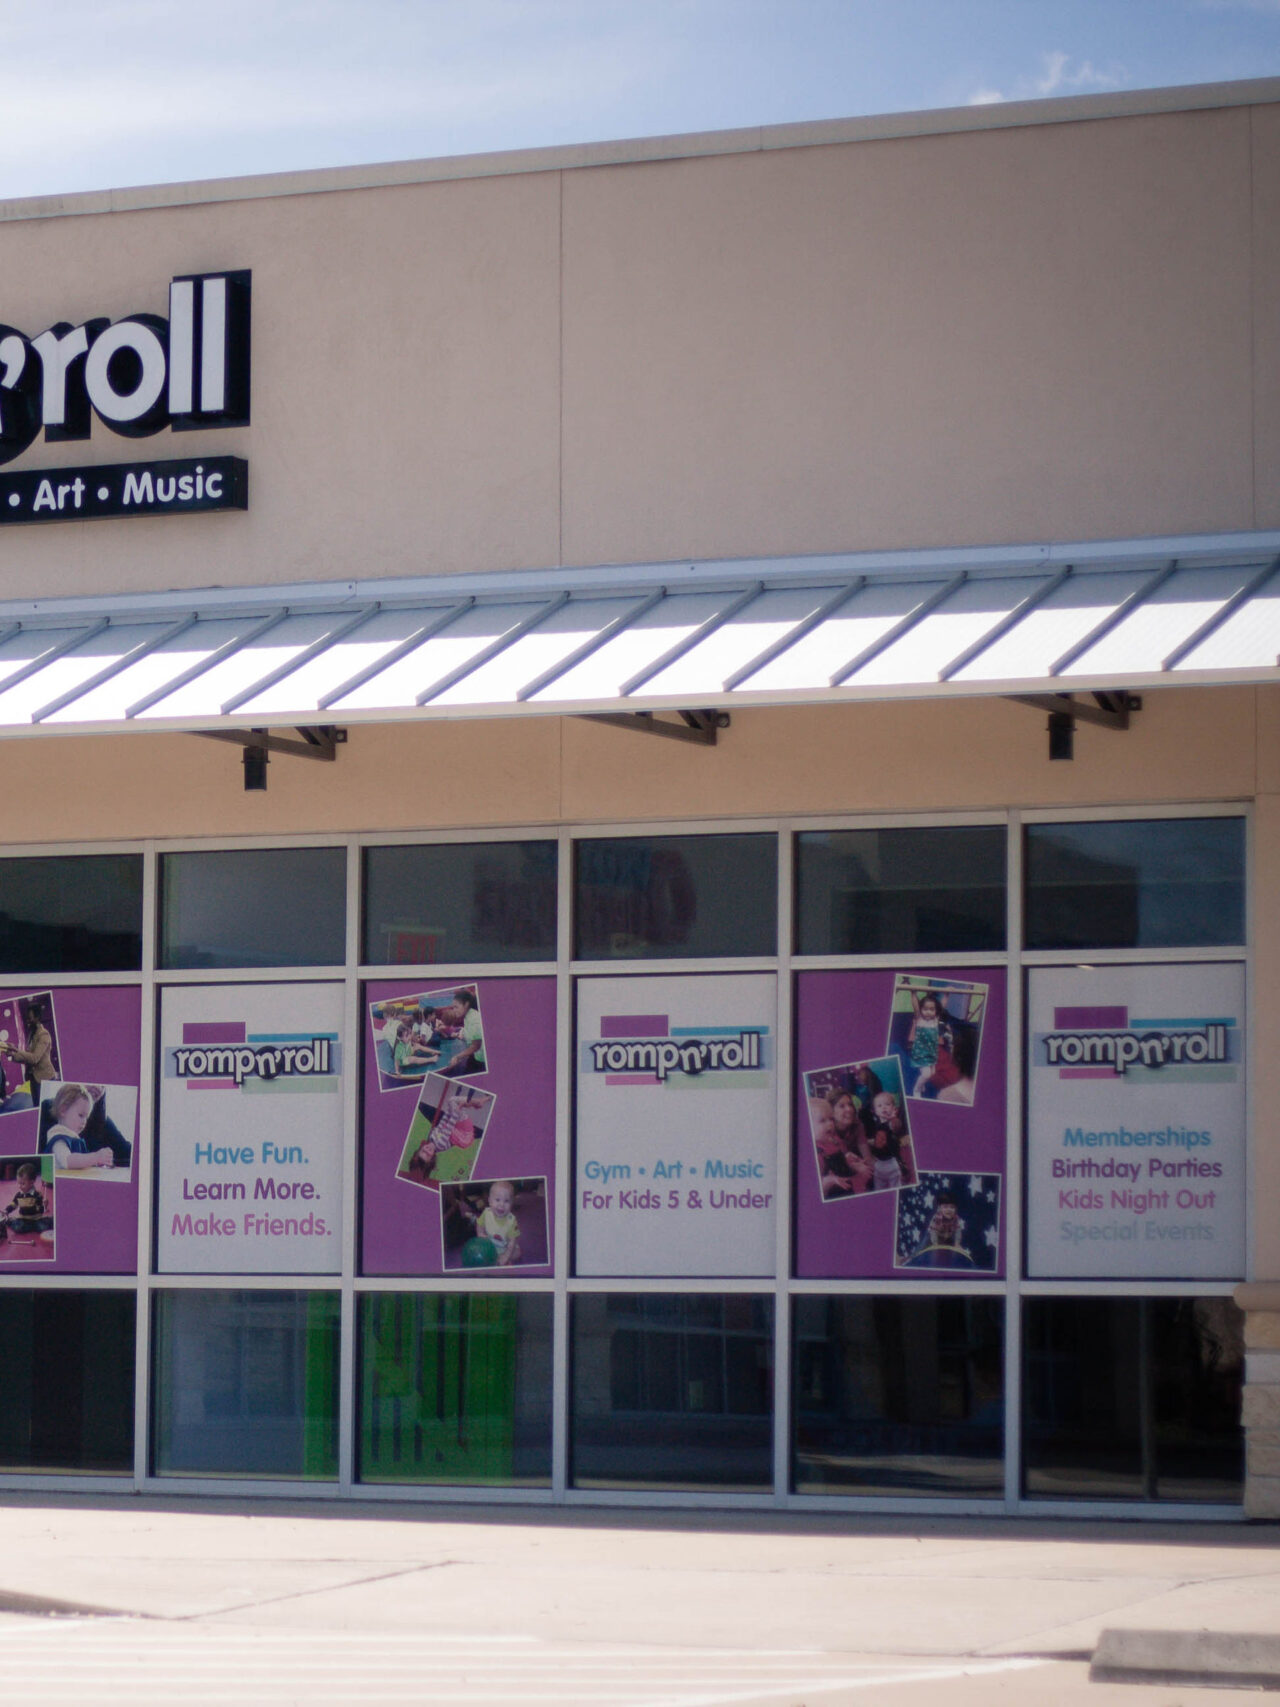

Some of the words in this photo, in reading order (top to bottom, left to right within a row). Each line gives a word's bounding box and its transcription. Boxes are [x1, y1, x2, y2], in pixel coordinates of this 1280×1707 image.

[32, 477, 85, 512] Art
[122, 467, 223, 505] Music
[1063, 1126, 1211, 1150] Memberships
[194, 1142, 254, 1165] Have
[262, 1141, 309, 1164] Fun.
[584, 1161, 631, 1184] Gym
[653, 1160, 682, 1179] Art
[704, 1159, 764, 1179] Music
[1052, 1158, 1141, 1182] Birthday
[1148, 1158, 1223, 1178] Parties
[183, 1178, 245, 1200] Learn
[253, 1178, 321, 1200] More.
[582, 1191, 613, 1209] For
[619, 1189, 661, 1210] Kids
[668, 1190, 680, 1209] 5
[687, 1190, 703, 1209] &
[709, 1189, 772, 1209] Under
[1058, 1189, 1104, 1210] Kids
[1110, 1189, 1170, 1214] Night
[1176, 1189, 1216, 1209] Out
[171, 1212, 236, 1236] Make
[243, 1212, 332, 1236] Friends.
[1060, 1221, 1138, 1245] Special
[1145, 1221, 1214, 1241] Events
